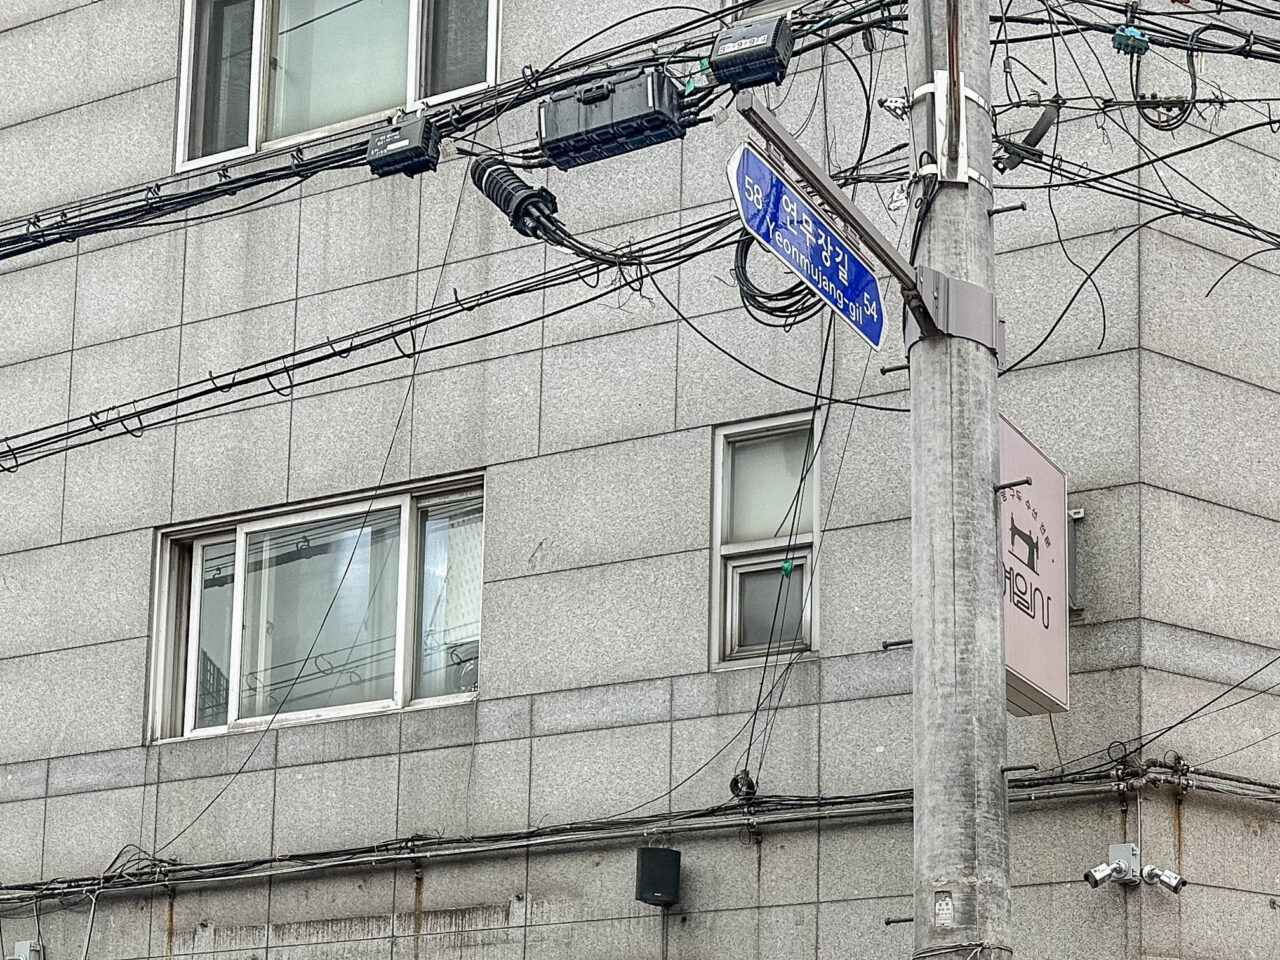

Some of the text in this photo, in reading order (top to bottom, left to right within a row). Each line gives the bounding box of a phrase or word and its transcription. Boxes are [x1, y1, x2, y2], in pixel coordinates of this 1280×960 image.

[744, 176, 763, 210] 58
[766, 216, 863, 325] Yeonmujang-gil
[782, 194, 848, 287] 연무장길
[863, 293, 878, 322] 54
